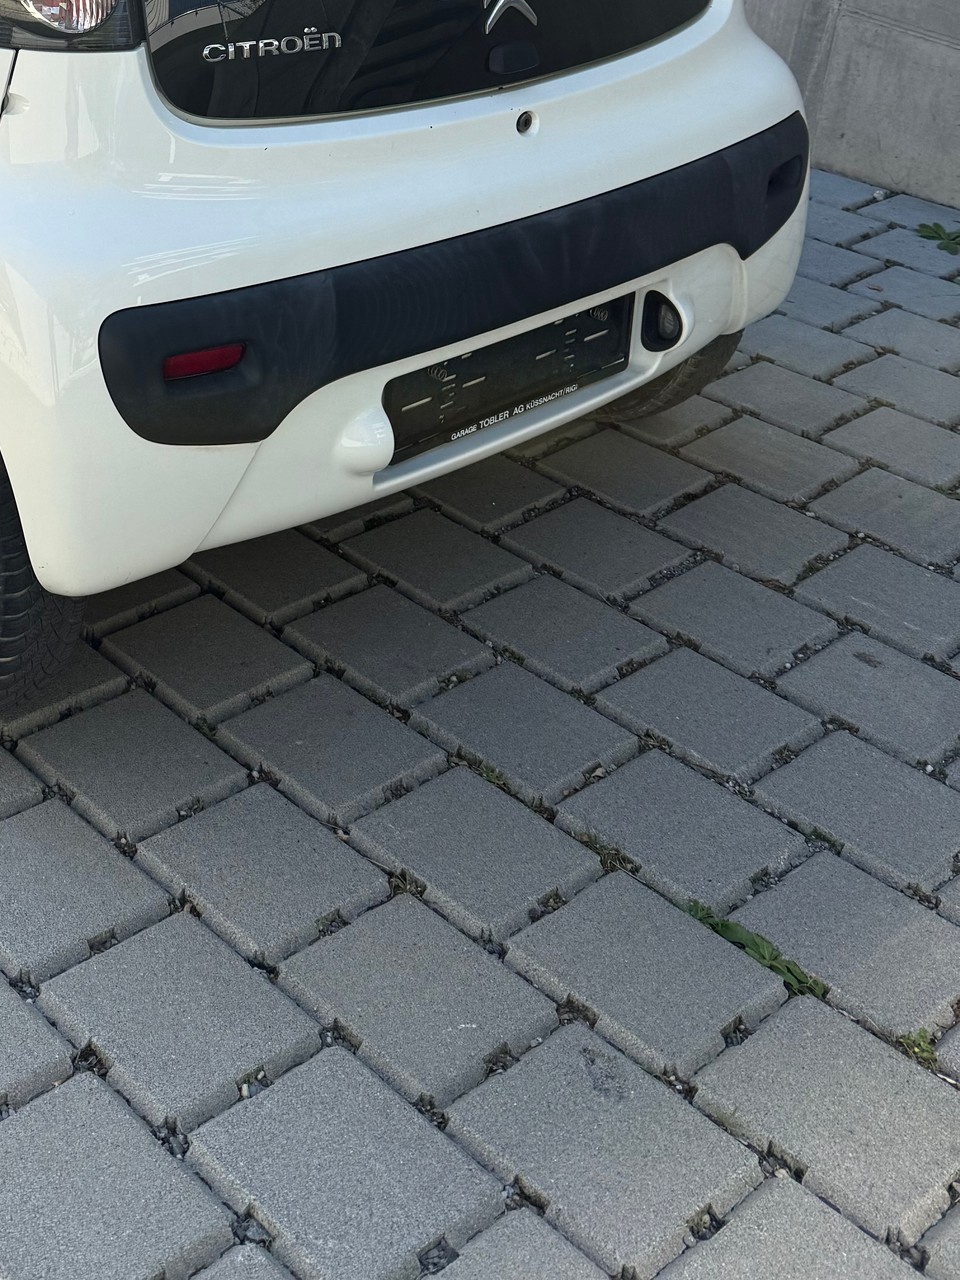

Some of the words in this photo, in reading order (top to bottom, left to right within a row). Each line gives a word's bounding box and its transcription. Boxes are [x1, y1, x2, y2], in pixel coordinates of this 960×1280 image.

[451, 424, 478, 441] GARAGE
[479, 410, 510, 429] TOBLER
[512, 404, 525, 416] AG
